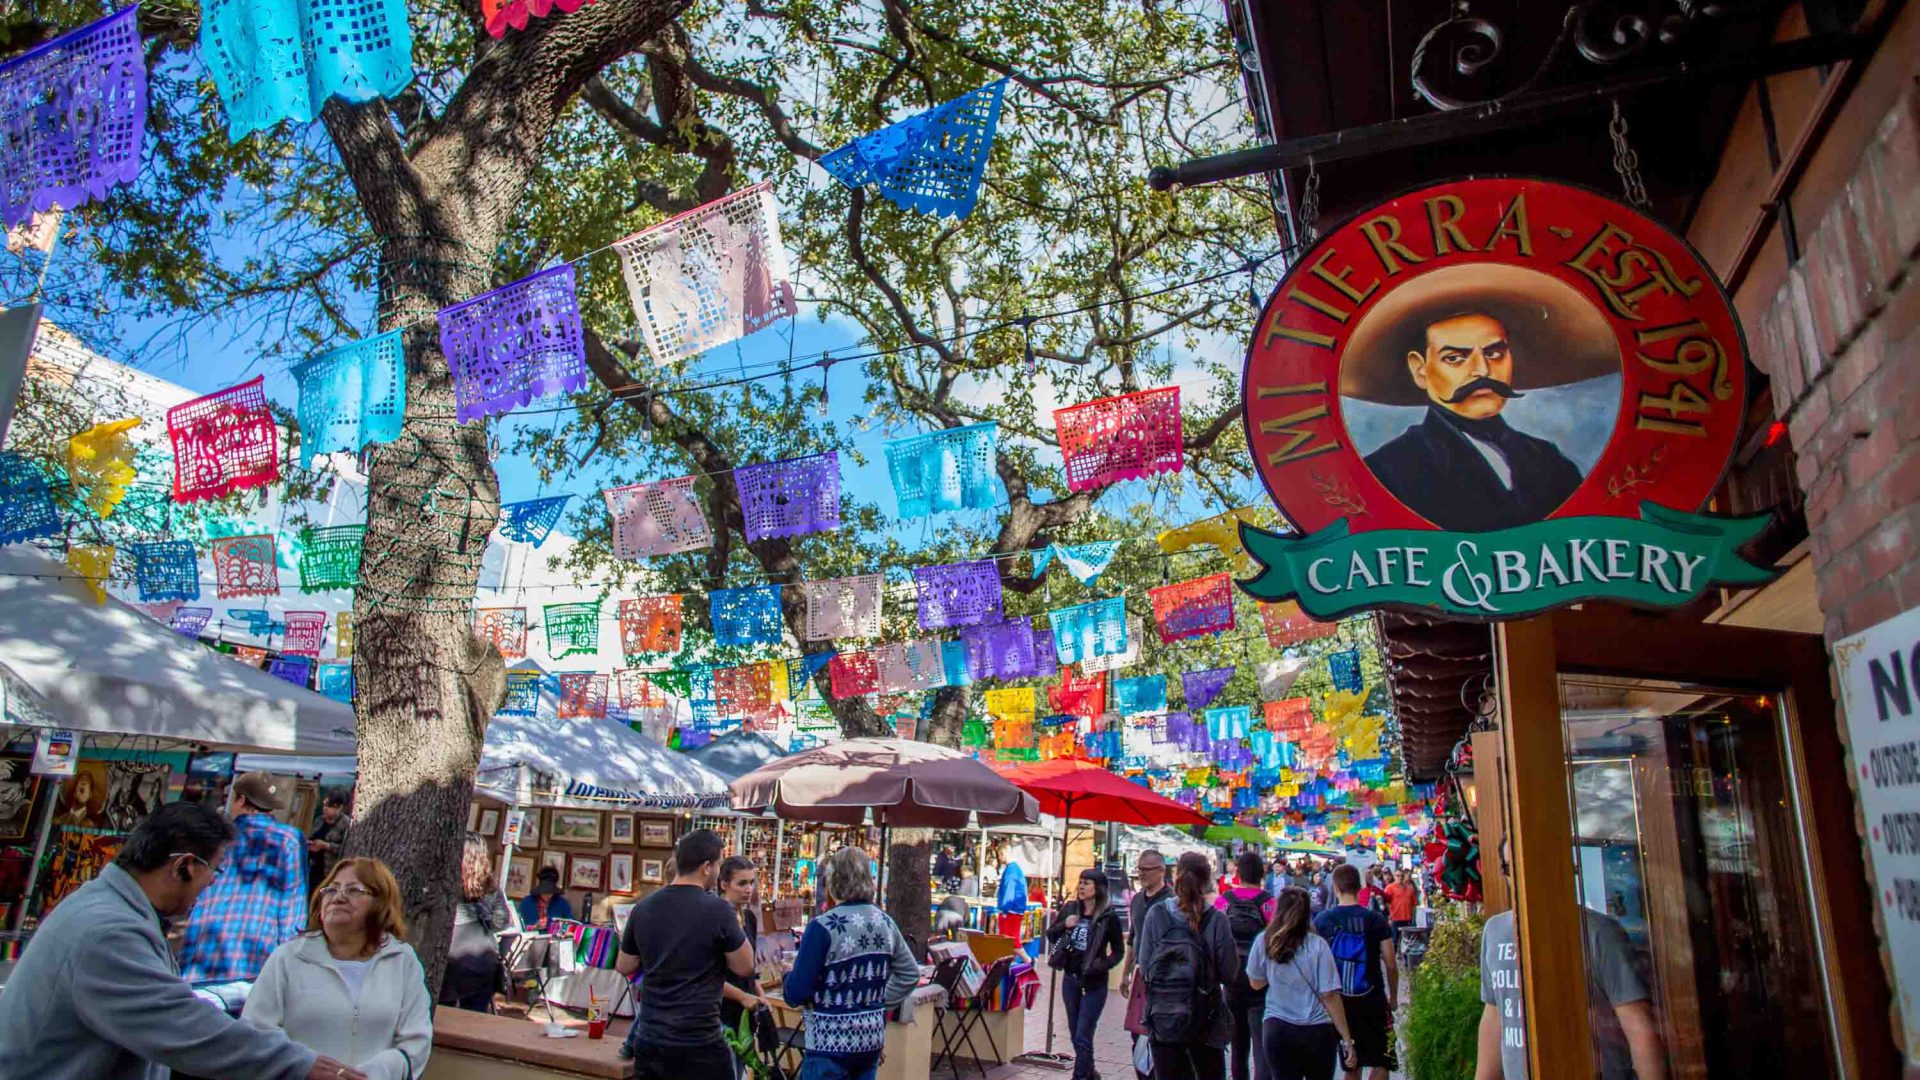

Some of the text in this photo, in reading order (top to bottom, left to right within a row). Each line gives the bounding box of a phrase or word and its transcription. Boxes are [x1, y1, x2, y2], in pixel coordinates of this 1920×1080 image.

[1265, 192, 1535, 353] TIERRA
[1634, 317, 1735, 439] 1941
[1257, 379, 1343, 467] MI
[1308, 538, 1707, 612] CAFE & BAKERY
[1868, 640, 1920, 722] N
